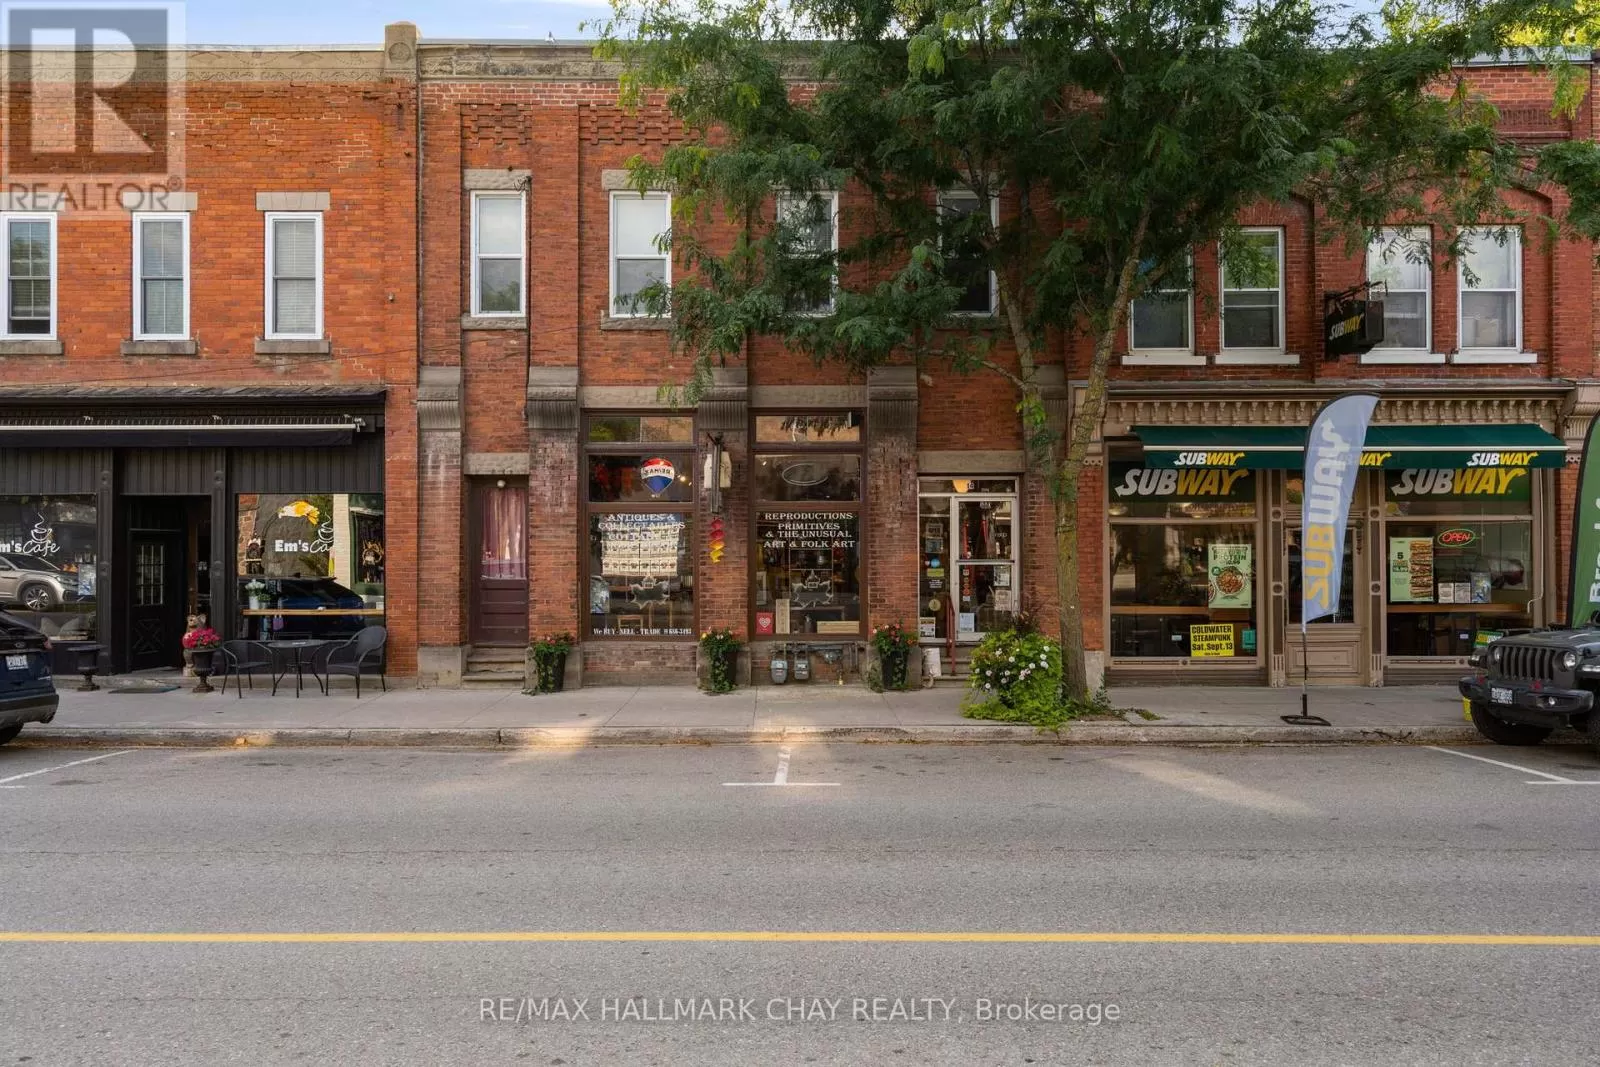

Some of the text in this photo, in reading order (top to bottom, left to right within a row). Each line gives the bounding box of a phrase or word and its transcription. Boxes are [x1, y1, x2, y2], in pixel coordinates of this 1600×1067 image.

[1329, 313, 1364, 341] SUBWAY
[1173, 451, 1245, 466] SUBWAY
[1359, 452, 1392, 466] WAY
[1466, 451, 1539, 466] SUBWAY
[1114, 468, 1249, 497] SUBWAY
[1391, 467, 1527, 496] SUBWAY
[607, 513, 676, 521] ANTIQUES &
[765, 512, 853, 520] REPRODUCTIONS
[1304, 418, 1350, 609] SUBWAY
[778, 522, 840, 530] PRIMITIVES
[777, 530, 800, 538] THE
[801, 530, 852, 538] UNUSUAL
[1442, 532, 1471, 542] OPEN
[0, 540, 22, 553] m's
[274, 539, 309, 553] Em's
[763, 540, 856, 548] ART & FOLK ART
[1191, 625, 1232, 634] COLDWATER
[1193, 634, 1231, 642] STEAMPUNK
